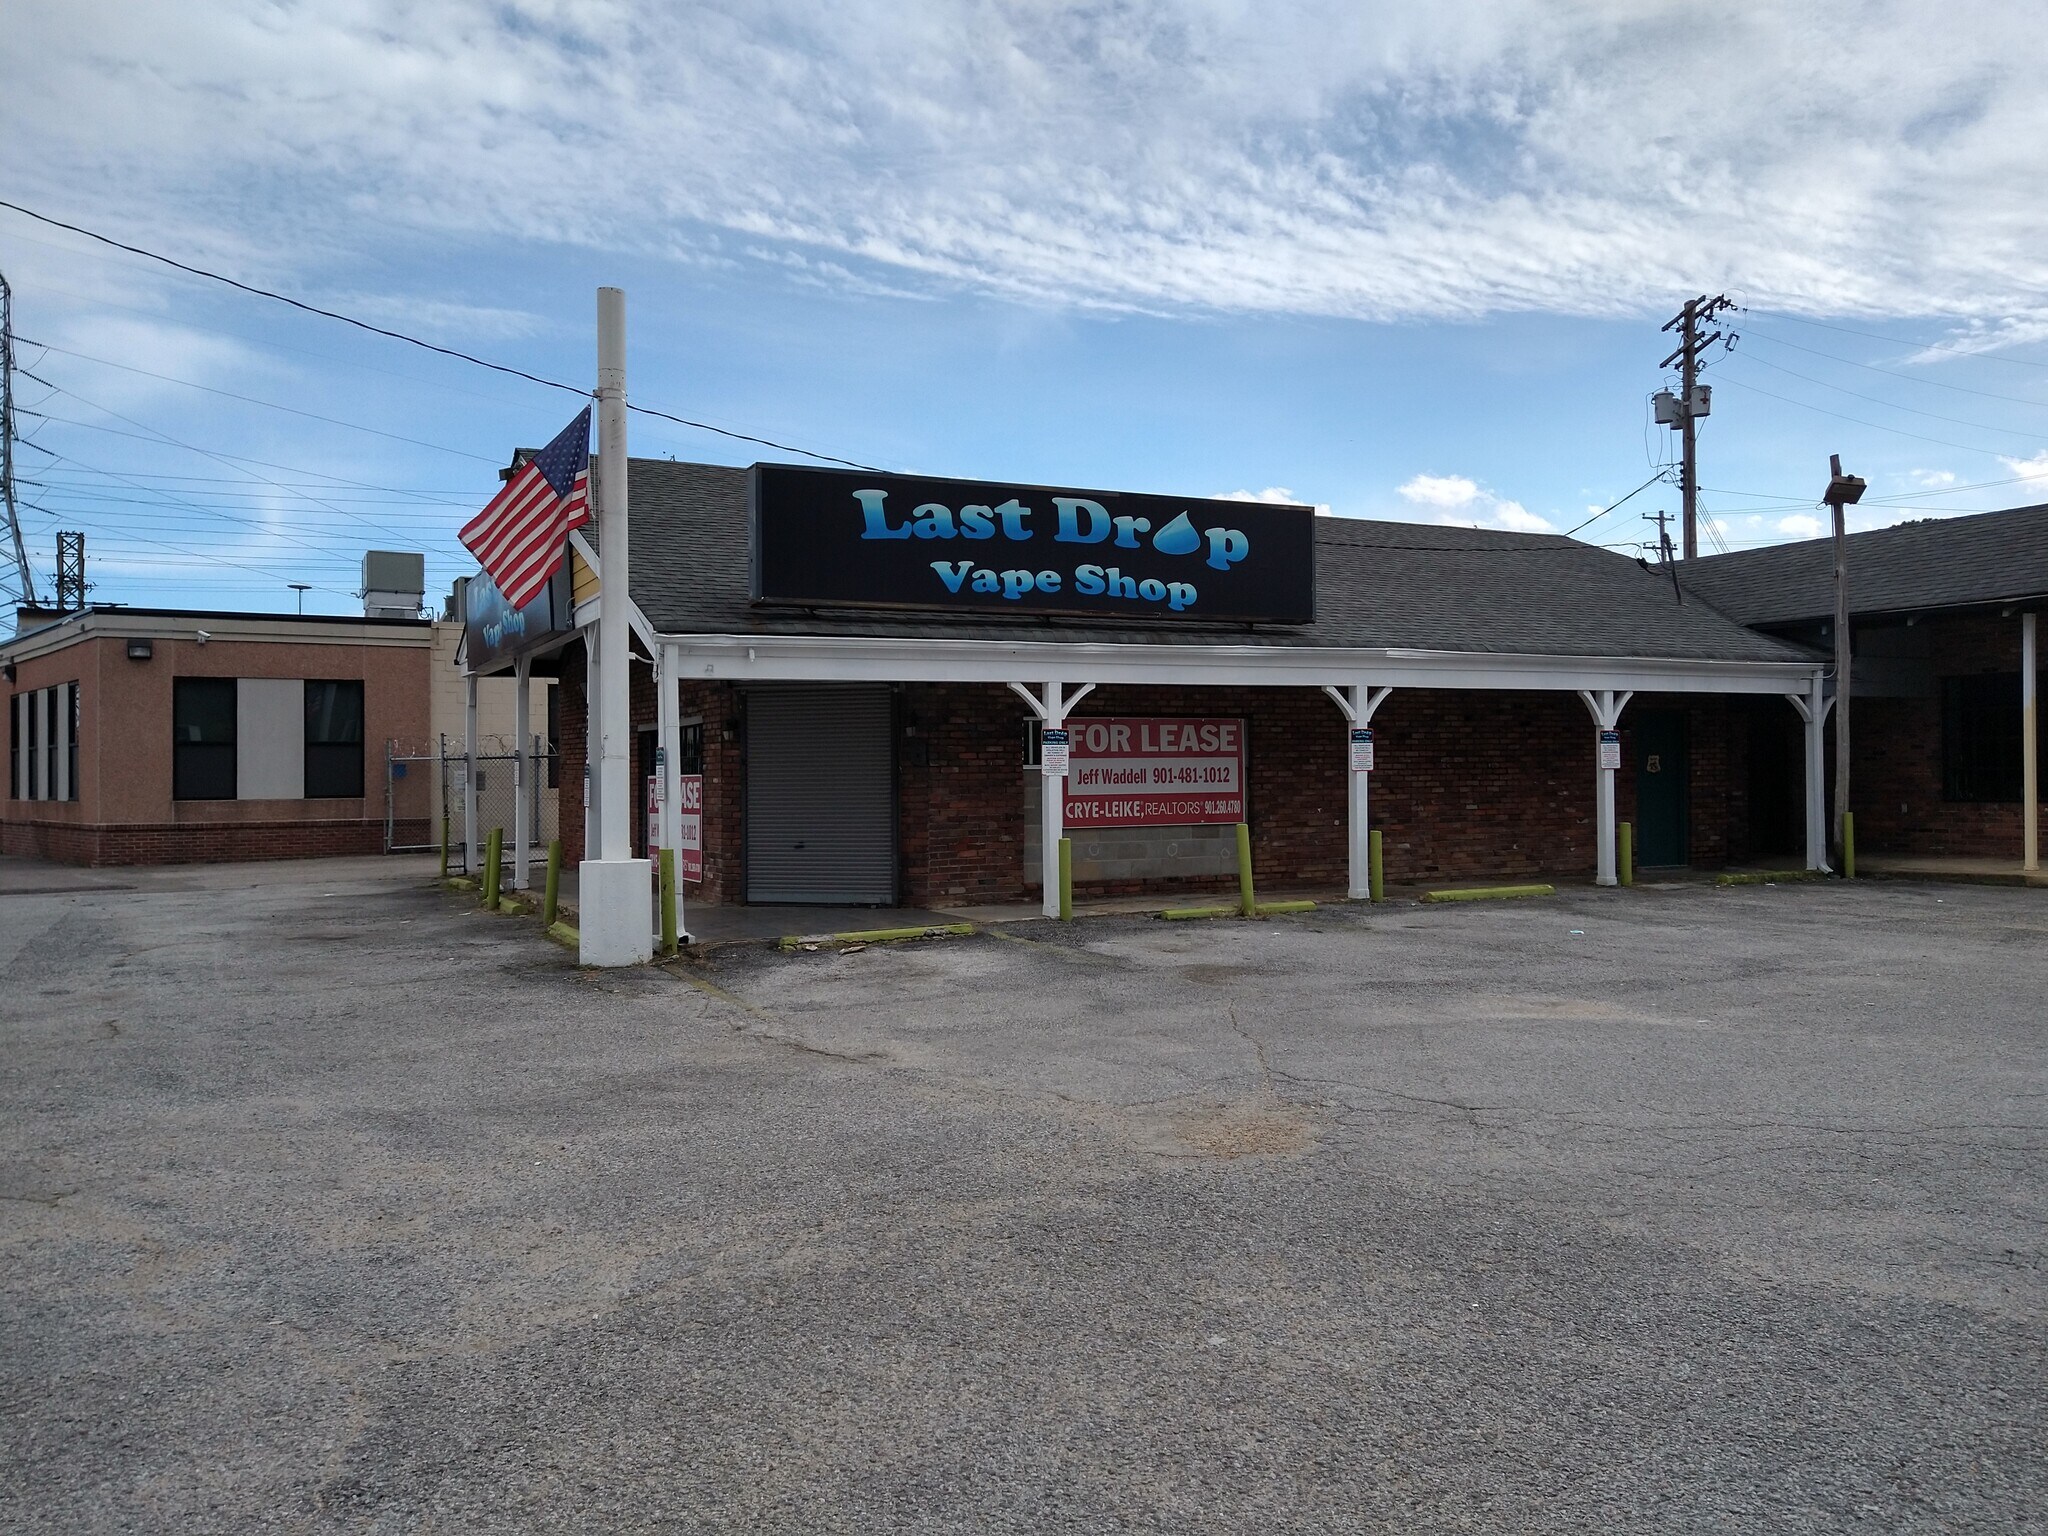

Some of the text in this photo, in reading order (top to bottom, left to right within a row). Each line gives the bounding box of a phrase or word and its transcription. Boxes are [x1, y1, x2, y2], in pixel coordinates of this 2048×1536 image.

[852, 488, 1034, 541] Last
[930, 560, 1198, 611] Vape Shop
[502, 608, 526, 638] Shop
[1068, 724, 1238, 753] FOR LEASE
[1077, 766, 1230, 786] Jeff Waddell 901-481-1012
[681, 781, 701, 809] ASE
